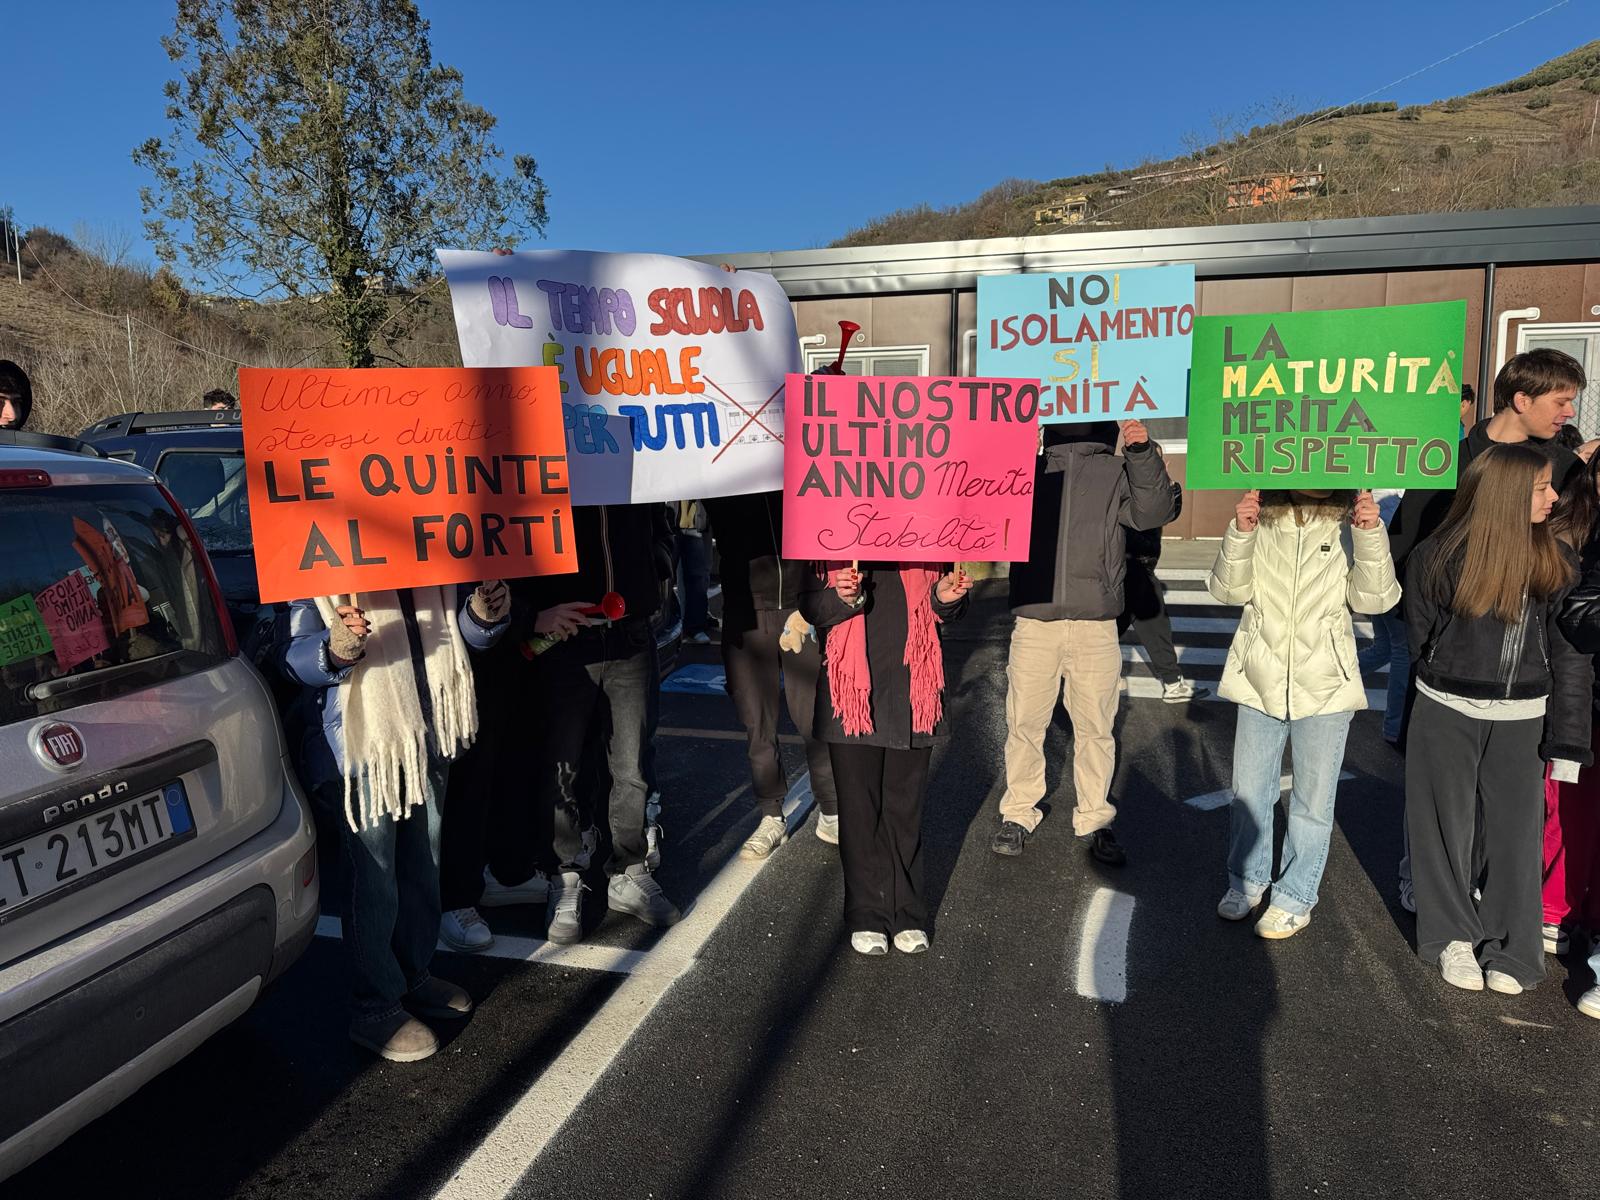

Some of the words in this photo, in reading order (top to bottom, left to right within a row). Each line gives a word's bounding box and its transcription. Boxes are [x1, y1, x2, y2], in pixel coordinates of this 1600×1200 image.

[488, 275, 533, 329] IL
[536, 279, 636, 337] TEMPO
[647, 287, 764, 336] SCUOLA
[990, 304, 1195, 351] ISOLAMENTO
[1224, 322, 1290, 362] LA
[542, 333, 569, 394] È
[575, 346, 705, 396] UGUALE
[1222, 350, 1460, 399] MATURITÀ
[260, 374, 426, 411] Ultimo
[444, 382, 536, 406] anno,
[804, 376, 837, 417] IL
[857, 380, 1039, 423] NOSTRO
[1222, 394, 1378, 435] MERITA
[256, 420, 379, 451] stessi
[562, 403, 619, 454] PER
[618, 402, 721, 452] TUTTI
[801, 419, 951, 458] ULTIMO
[264, 458, 335, 503] LE
[359, 446, 569, 496] QUINTE
[1222, 433, 1453, 477] RISPETTO
[796, 460, 925, 500] ANNO
[933, 460, 1033, 497] Merita
[299, 519, 387, 570] AL
[412, 509, 564, 562] FORTI
[47, 732, 79, 758] FIAT
[42, 781, 129, 823] panda
